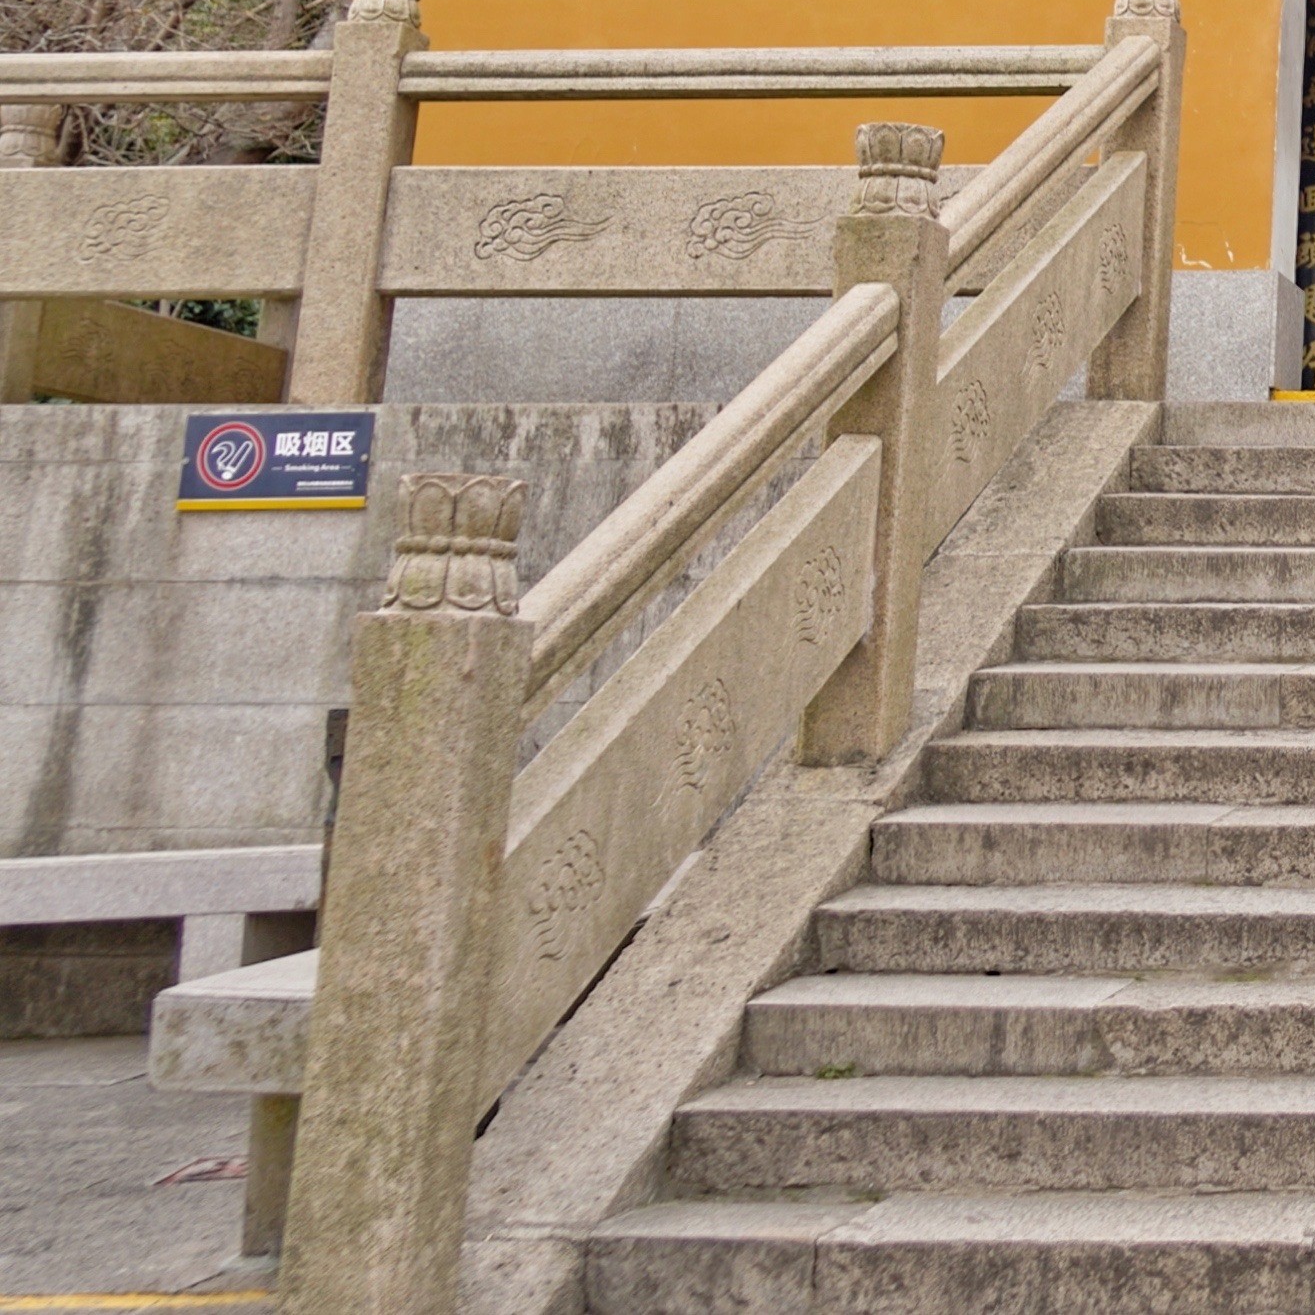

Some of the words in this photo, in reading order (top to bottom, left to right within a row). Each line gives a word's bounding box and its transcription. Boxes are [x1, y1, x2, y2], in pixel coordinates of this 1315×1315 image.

[274, 431, 356, 457] 吸烟区
[284, 463, 319, 473] Smoking
[320, 463, 341, 472] Area
